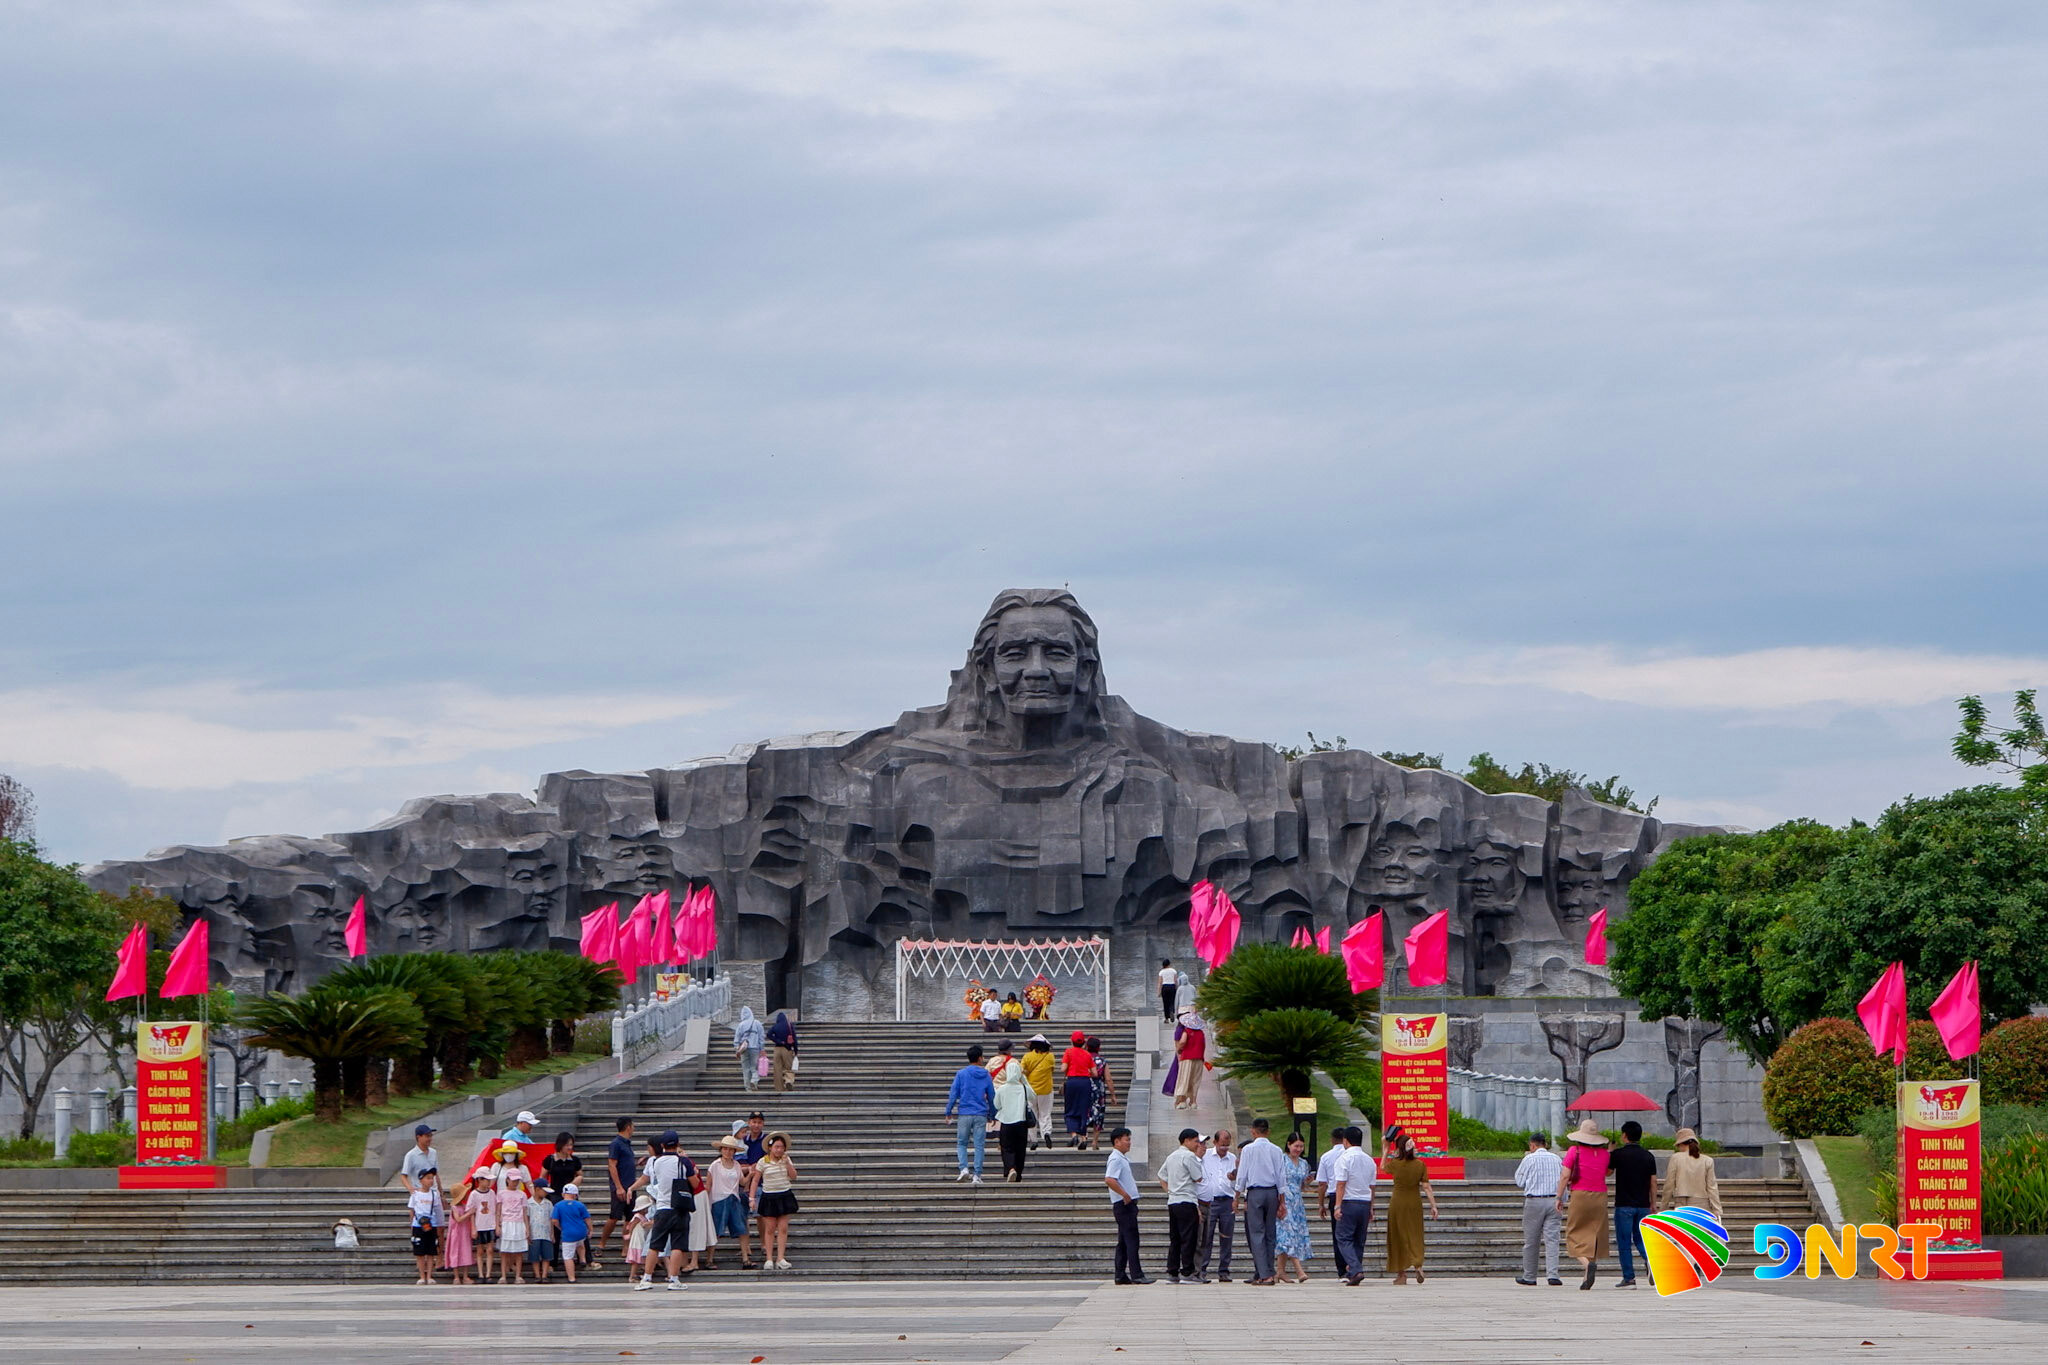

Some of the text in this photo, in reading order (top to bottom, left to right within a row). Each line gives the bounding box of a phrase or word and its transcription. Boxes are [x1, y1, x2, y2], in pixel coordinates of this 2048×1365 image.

[1414, 1030, 1428, 1038] 81
[169, 1038, 182, 1047] 81
[151, 1070, 168, 1080] TINH
[148, 1085, 191, 1100] CÁCH MẠNG
[149, 1102, 190, 1114] THÁNG TÁM
[1942, 1101, 1958, 1110] 81
[141, 1117, 198, 1132] VÀ QUỐC KHÁNH
[145, 1134, 193, 1150] 2-9 BẤT DIỆT!
[1920, 1138, 1940, 1150] TINH
[1918, 1156, 1968, 1173] CÁCH MẠNG
[1919, 1176, 1967, 1190] THÁNG TÁM
[1910, 1194, 1976, 1211] VÀ QUỐC KHÁNH
[1950, 1215, 1971, 1232] DIỆT!
